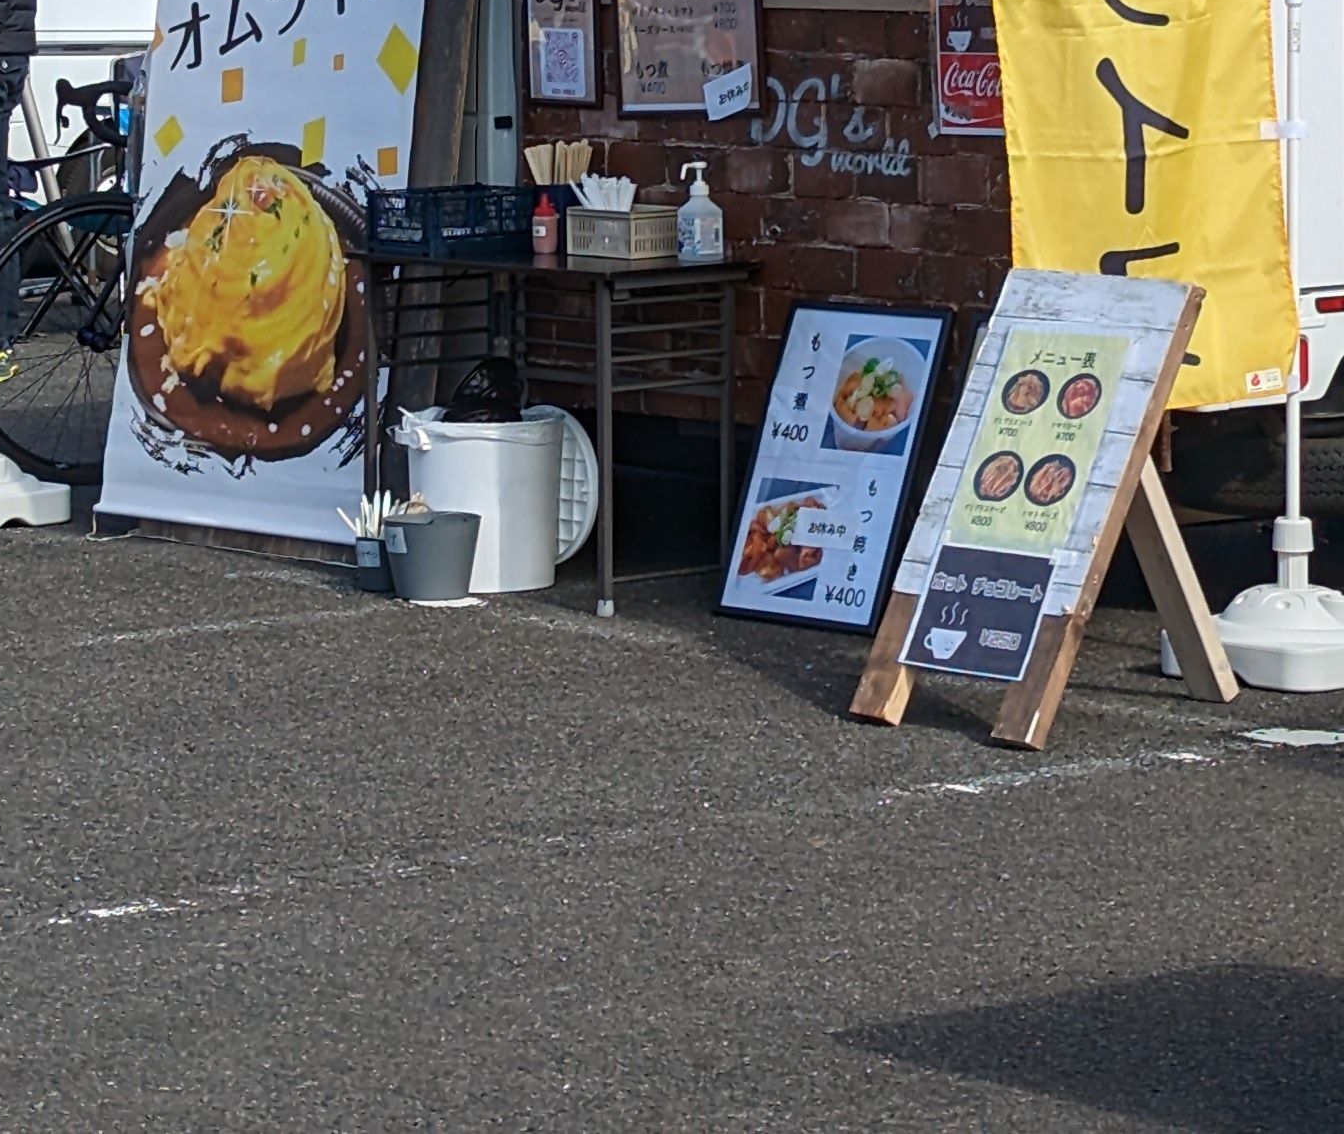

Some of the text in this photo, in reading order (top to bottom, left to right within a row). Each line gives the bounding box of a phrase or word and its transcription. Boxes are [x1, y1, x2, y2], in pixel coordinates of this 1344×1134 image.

[831, 138, 912, 176] world
[793, 332, 821, 411] もつ煮
[771, 422, 809, 443] ¥400
[825, 586, 866, 608] ¥400
